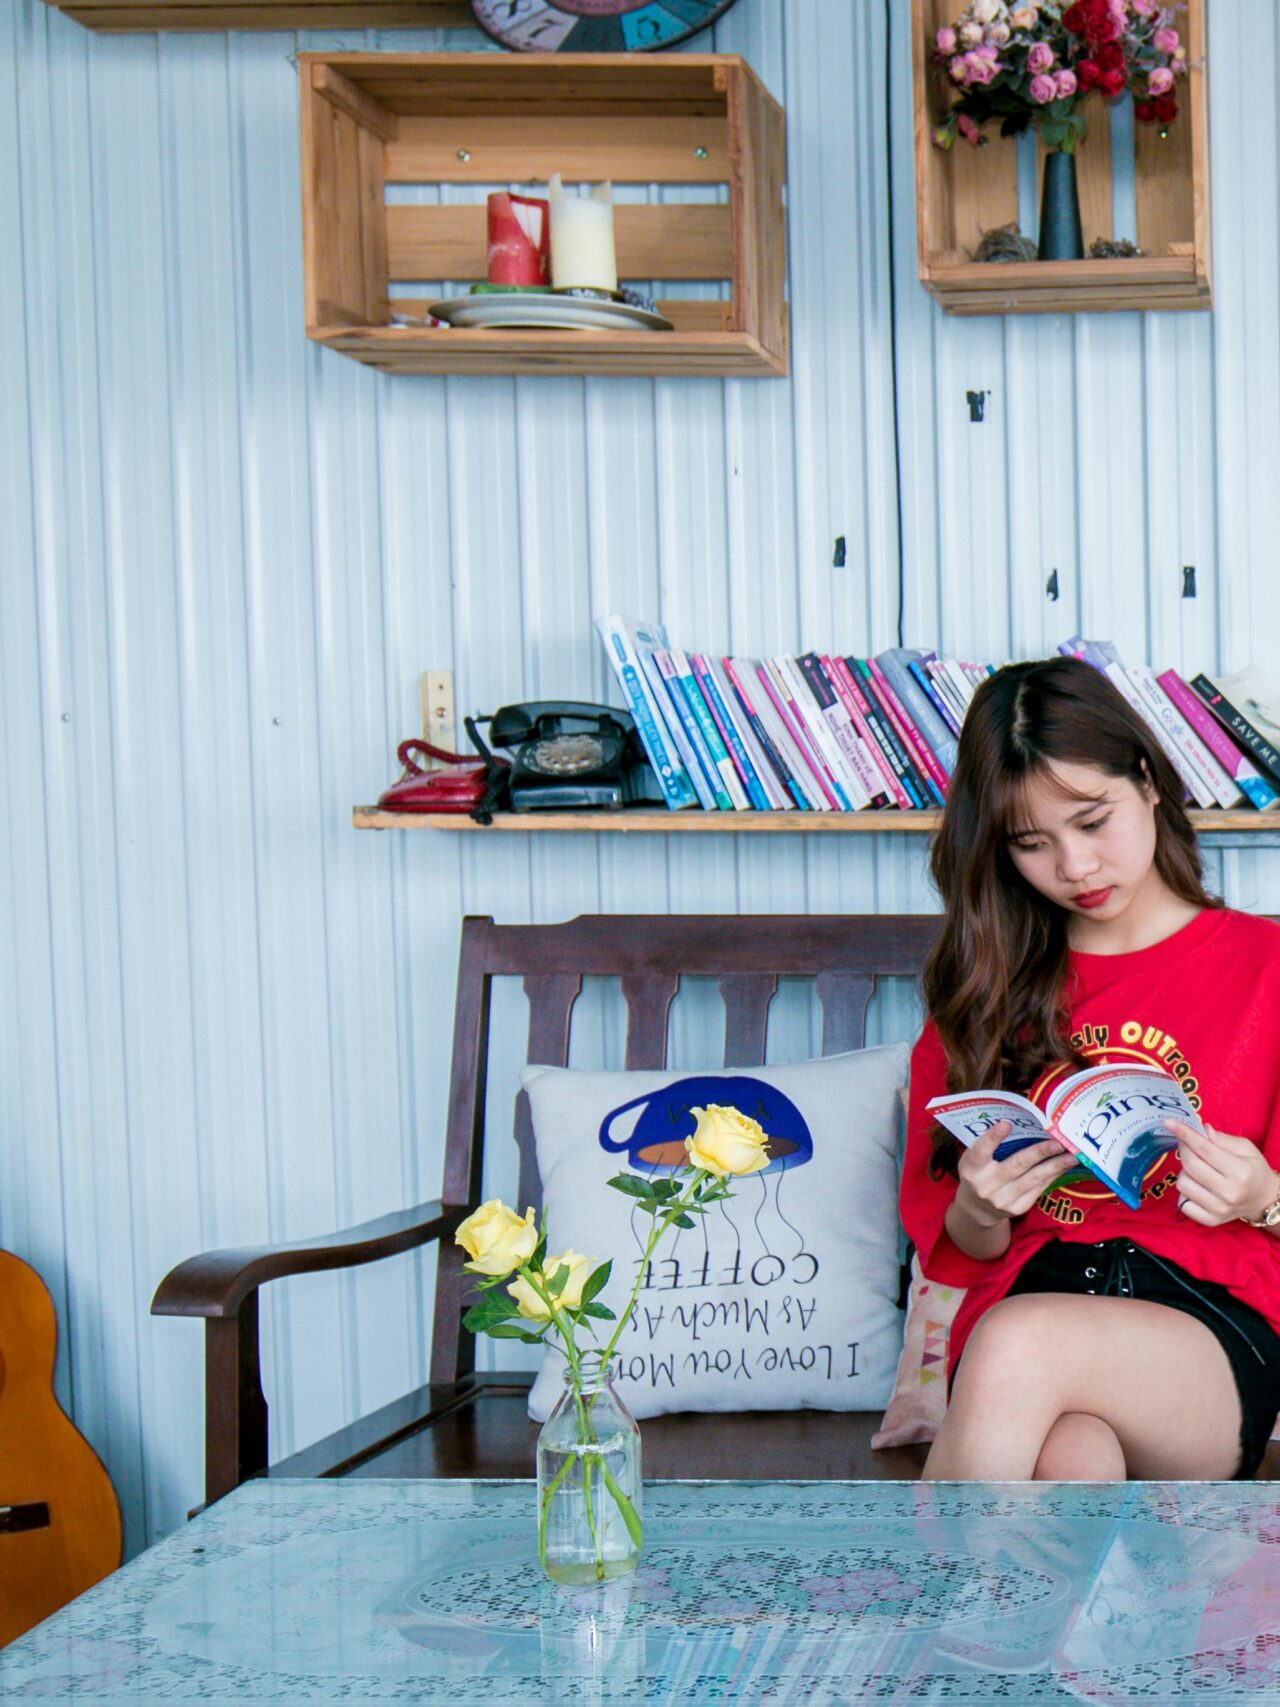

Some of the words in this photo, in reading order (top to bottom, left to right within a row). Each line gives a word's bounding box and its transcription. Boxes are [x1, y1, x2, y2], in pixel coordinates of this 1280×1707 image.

[523, 18, 566, 47] 7
[1231, 716, 1260, 747] SAVE
[1259, 747, 1278, 766] ME
[1070, 1022, 1109, 1050] sly
[1120, 1020, 1202, 1112] OUTrage
[1062, 1072, 1114, 1111] INTERNATIONAL
[668, 1098, 775, 1125] YM
[1083, 1094, 1190, 1152] ping
[630, 1249, 820, 1292] COFFEE
[630, 1298, 665, 1340] As
[671, 1297, 770, 1341] Much
[777, 1295, 816, 1332] As
[611, 1351, 675, 1388] Mor
[683, 1347, 752, 1380] You
[756, 1345, 833, 1380] Love
[847, 1342, 860, 1379] I
